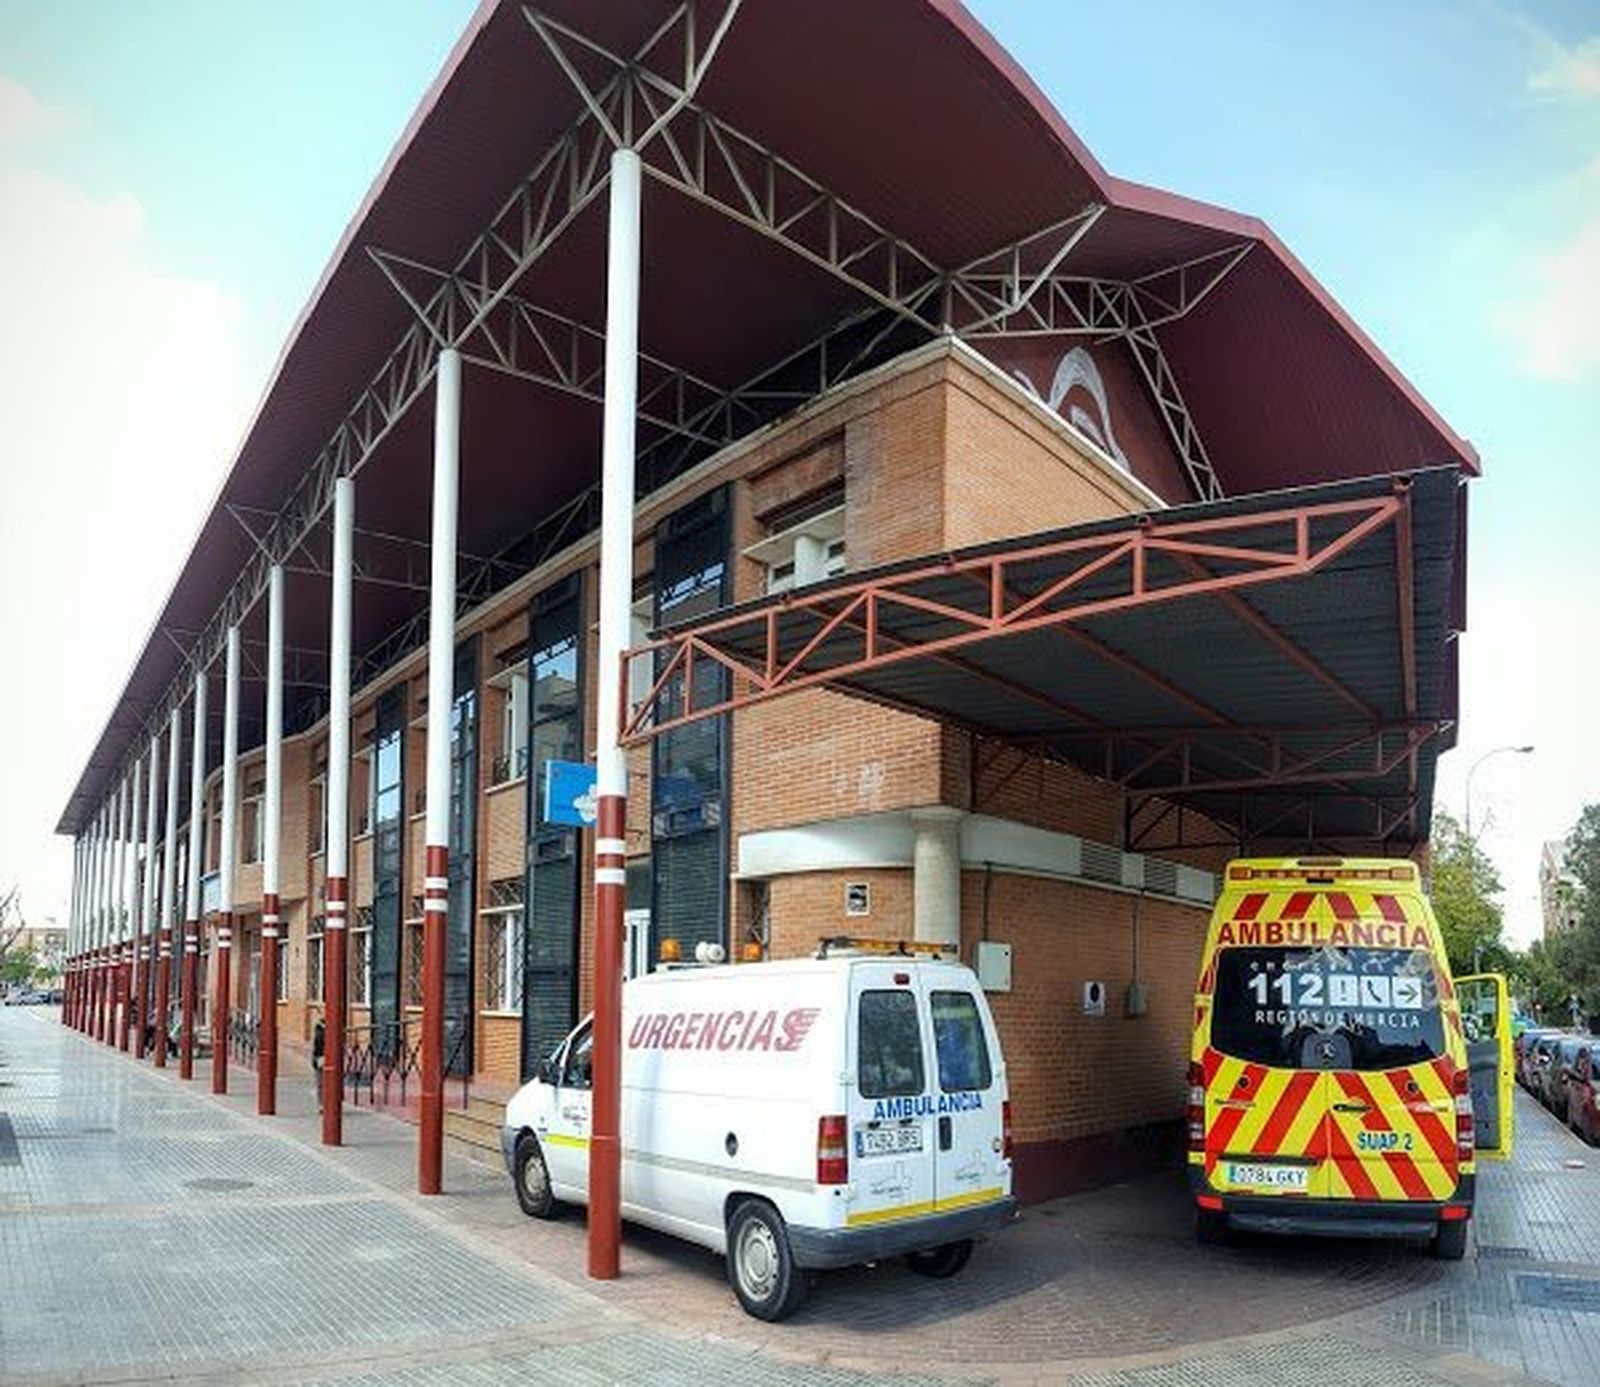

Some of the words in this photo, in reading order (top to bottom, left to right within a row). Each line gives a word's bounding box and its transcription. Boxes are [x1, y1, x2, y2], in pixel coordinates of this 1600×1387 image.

[1217, 922, 1430, 948] AMBULANCIA
[1248, 973, 1324, 1004] 112
[628, 1008, 821, 1051] URGENCIAS
[874, 1092, 983, 1119] AMBULANCIA
[1357, 1131, 1398, 1150] SUAP
[1404, 1133, 1413, 1150] 2
